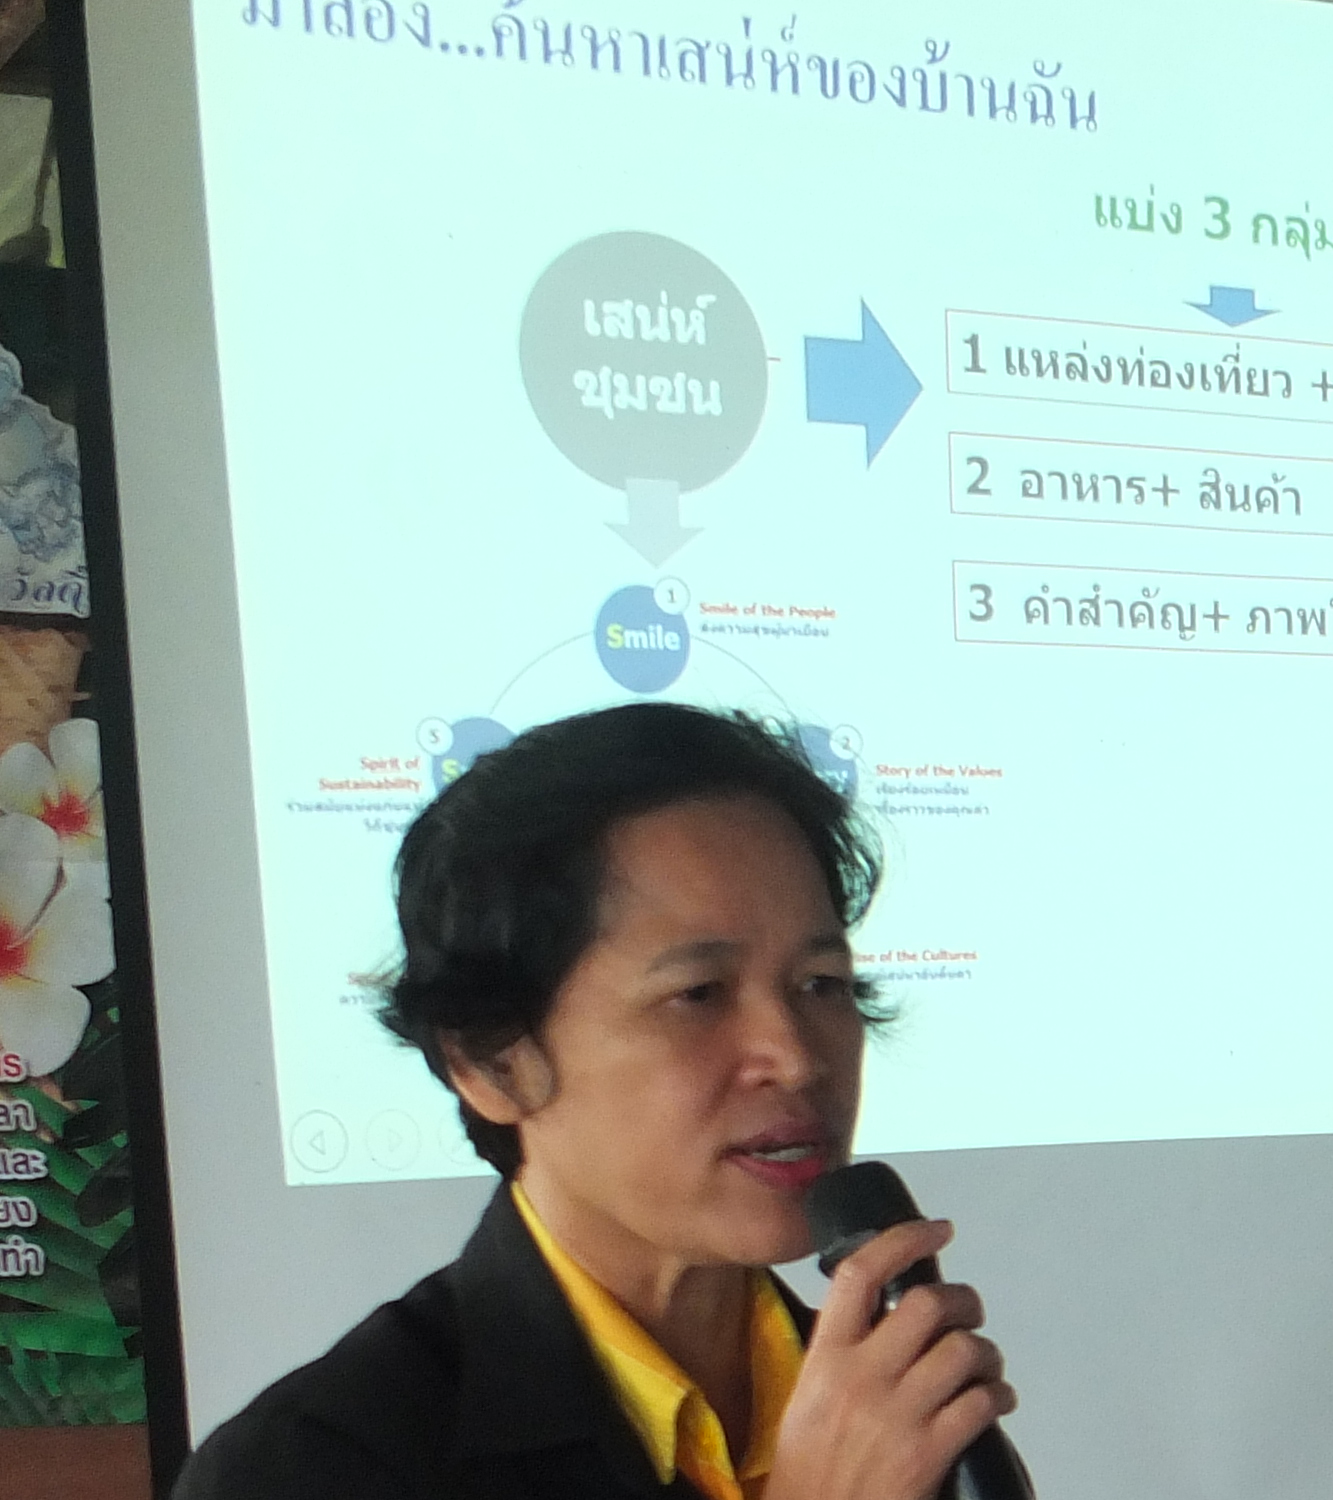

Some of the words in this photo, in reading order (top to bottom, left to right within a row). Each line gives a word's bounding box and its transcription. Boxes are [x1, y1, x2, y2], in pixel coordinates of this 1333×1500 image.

[1094, 185, 1183, 235] แบ่ง
[1204, 196, 1232, 240] 3
[584, 289, 717, 345] เสน่ห์
[963, 334, 987, 373] 1
[1004, 341, 1294, 400] แหล่งท่องเที่ยว
[573, 365, 723, 420] ชุมชน
[966, 456, 992, 496] 2
[1198, 467, 1302, 516] สินค้า
[743, 603, 757, 615] of
[761, 604, 784, 617] the
[968, 584, 995, 623] 3
[606, 622, 681, 652] Smile
[405, 757, 420, 769] of
[876, 764, 911, 778] Story
[915, 764, 929, 776] of
[933, 765, 955, 777] the
[880, 950, 892, 962] of
